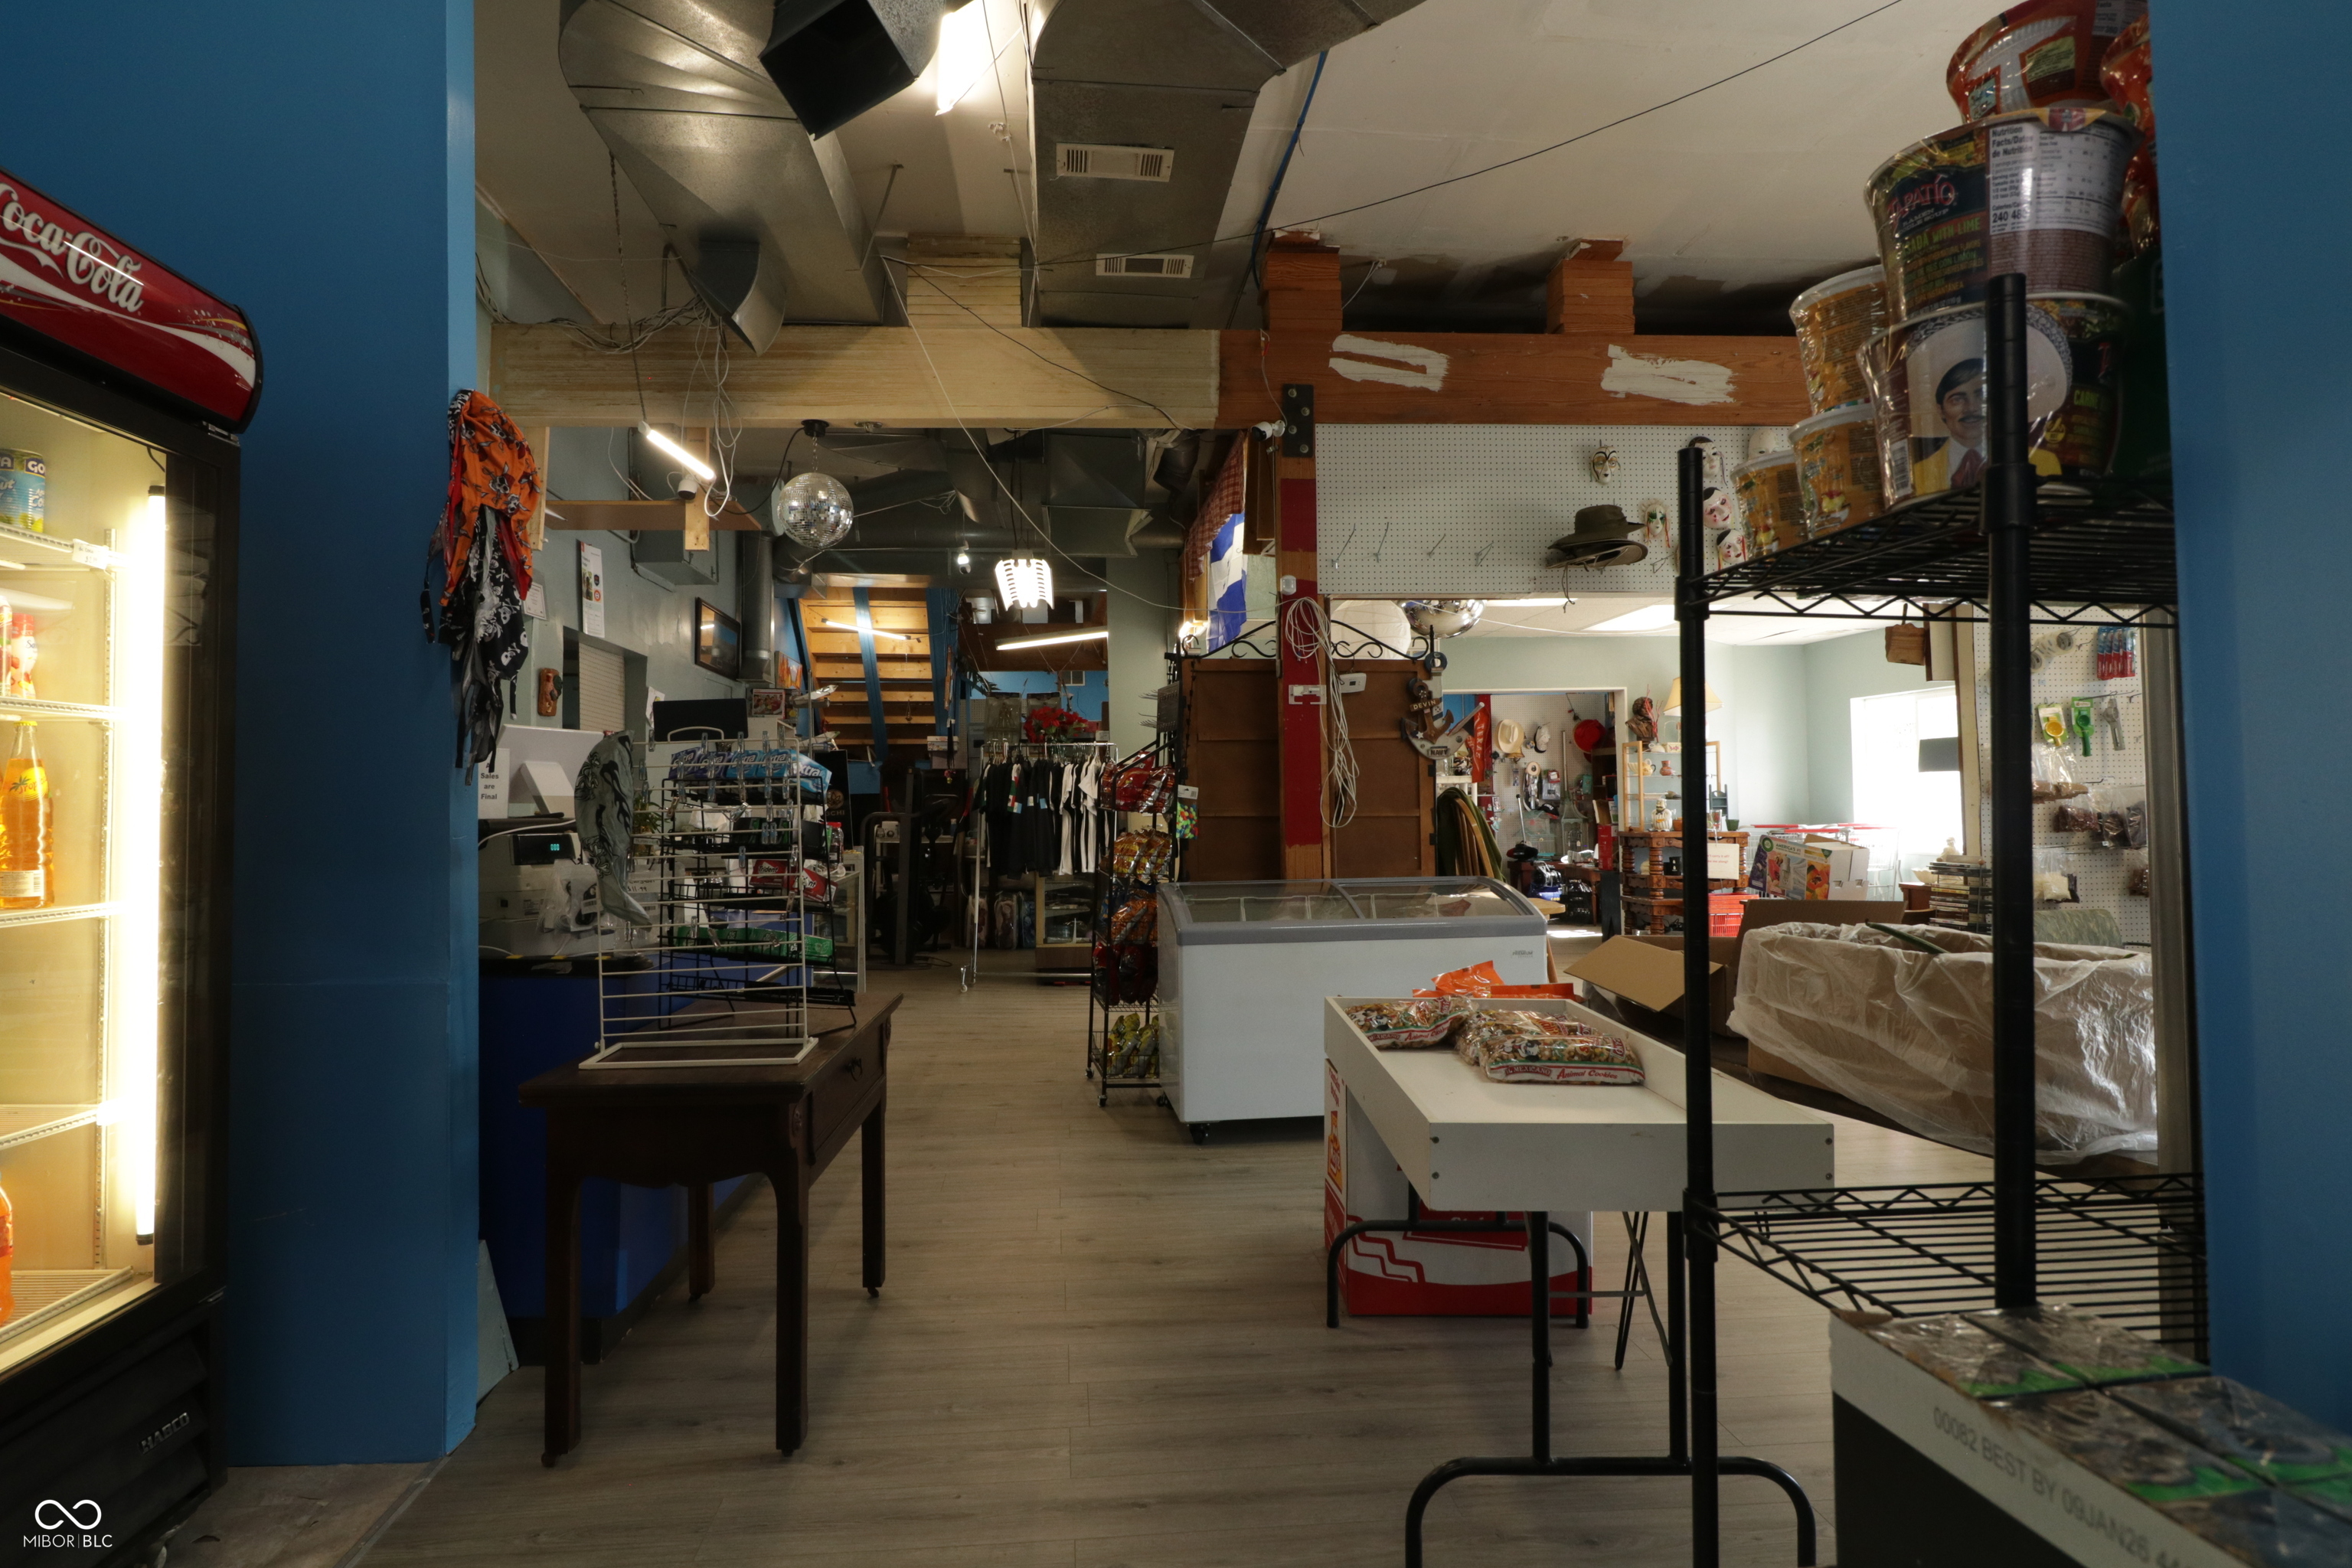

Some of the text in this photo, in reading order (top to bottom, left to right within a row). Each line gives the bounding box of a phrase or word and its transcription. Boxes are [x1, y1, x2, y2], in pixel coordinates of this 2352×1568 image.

[1992, 126, 2023, 137] Nutrition
[1992, 150, 2001, 158] de
[1992, 211, 2008, 224] 240
[1932, 224, 1955, 243] WITH
[1958, 217, 1981, 235] LIME
[1413, 700, 1436, 710] DEVIN
[1475, 723, 1485, 759] TEXAS
[1775, 843, 1796, 851] AMERICA'S
[758, 865, 779, 874] Trident
[1404, 1031, 1429, 1041] Animal
[1514, 1066, 1550, 1075] MEXICANO
[1557, 1068, 1586, 1080] Animal
[1588, 1070, 1618, 1080] Cookies
[140, 1411, 191, 1455] HABCO
[1933, 1406, 1978, 1453] 00082
[1981, 1436, 2027, 1485] BEST
[2031, 1468, 2057, 1504] BY
